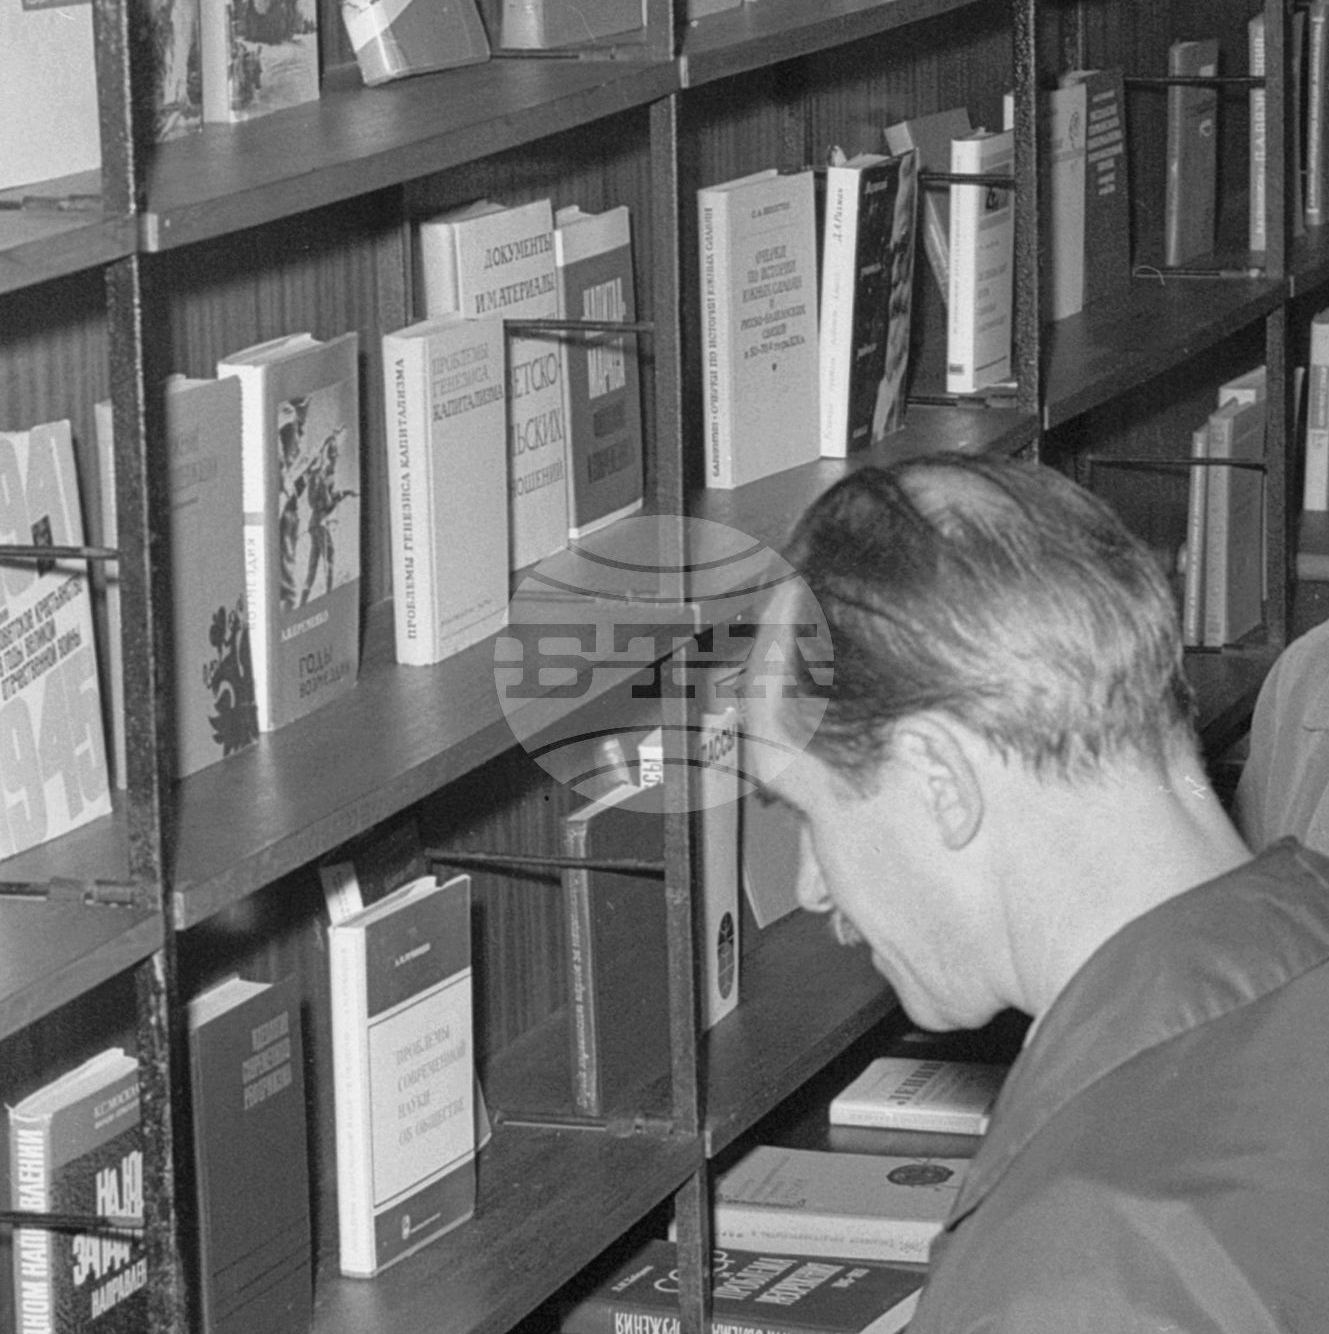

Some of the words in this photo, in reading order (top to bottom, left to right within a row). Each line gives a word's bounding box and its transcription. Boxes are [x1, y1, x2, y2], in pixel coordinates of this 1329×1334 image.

[484, 232, 553, 270] ДОКУМЕНТЫ
[475, 291, 486, 315] И
[486, 272, 556, 312] МАТЕРИАЛЫ
[432, 342, 489, 375] ПРОБЛЕМЫ
[510, 352, 562, 399] ЕТСКО-
[708, 351, 718, 368] ПО
[432, 365, 490, 399] ГЕНЕЗИСА
[432, 383, 504, 423] КАПИТАЛИЗМА
[394, 358, 411, 468] КАПИТАЛИЗМА
[400, 473, 414, 552] ГЕНЕЗИСА
[404, 556, 417, 640] ПРОБЛЕМЫ
[395, 1024, 450, 1065] ПРОБЛЕМЫ
[17, 1129, 48, 1277] НАПВЛЕНИИ
